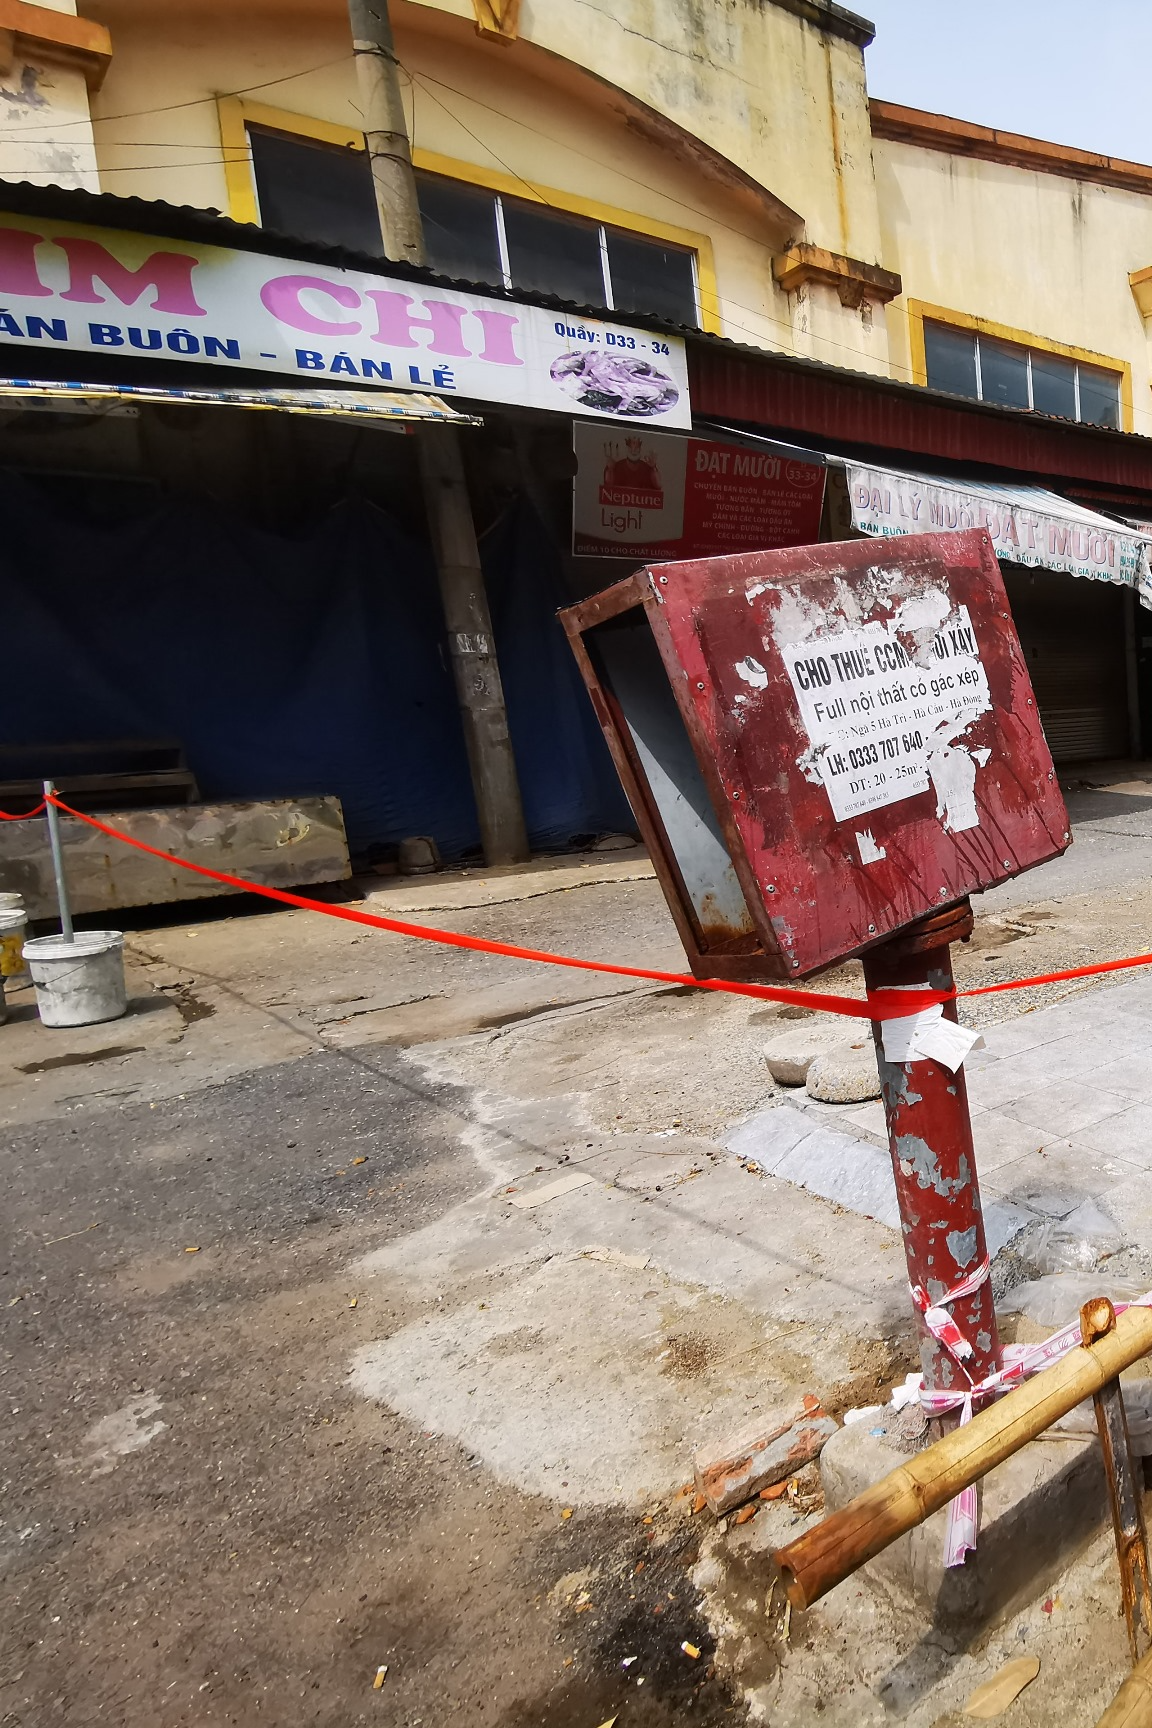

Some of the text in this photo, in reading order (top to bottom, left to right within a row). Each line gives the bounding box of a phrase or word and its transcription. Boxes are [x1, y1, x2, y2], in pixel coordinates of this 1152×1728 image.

[0, 227, 524, 366] IM CHI
[0, 308, 68, 342] ÁN
[88, 322, 241, 360] BUÔN
[295, 348, 393, 381] BÁN
[408, 364, 457, 390] LẺ
[554, 322, 601, 343] Quầy:
[605, 332, 636, 350] D33
[651, 341, 670, 356] 34
[695, 449, 731, 479] ĐẠT
[733, 454, 781, 480] MƯỜI
[788, 470, 817, 481] 33-34
[601, 488, 661, 506] Neptune
[854, 483, 891, 517] ĐẠI
[899, 492, 922, 520] LÝ
[601, 507, 643, 533] Light
[860, 521, 879, 534] BÁN
[794, 656, 832, 691] CHO
[873, 641, 911, 673] CCM
[949, 624, 975, 656] XÂY
[813, 666, 980, 722] Full nội thất có gác xép
[871, 721, 877, 732] 5
[877, 717, 892, 729] Hà
[913, 708, 926, 720] Hà
[950, 698, 962, 710] Hà
[826, 752, 849, 777] LH:
[849, 743, 879, 770] 0333
[879, 737, 899, 760] 707
[901, 730, 923, 754] 640
[849, 779, 872, 794] DT:
[874, 772, 886, 787] 20
